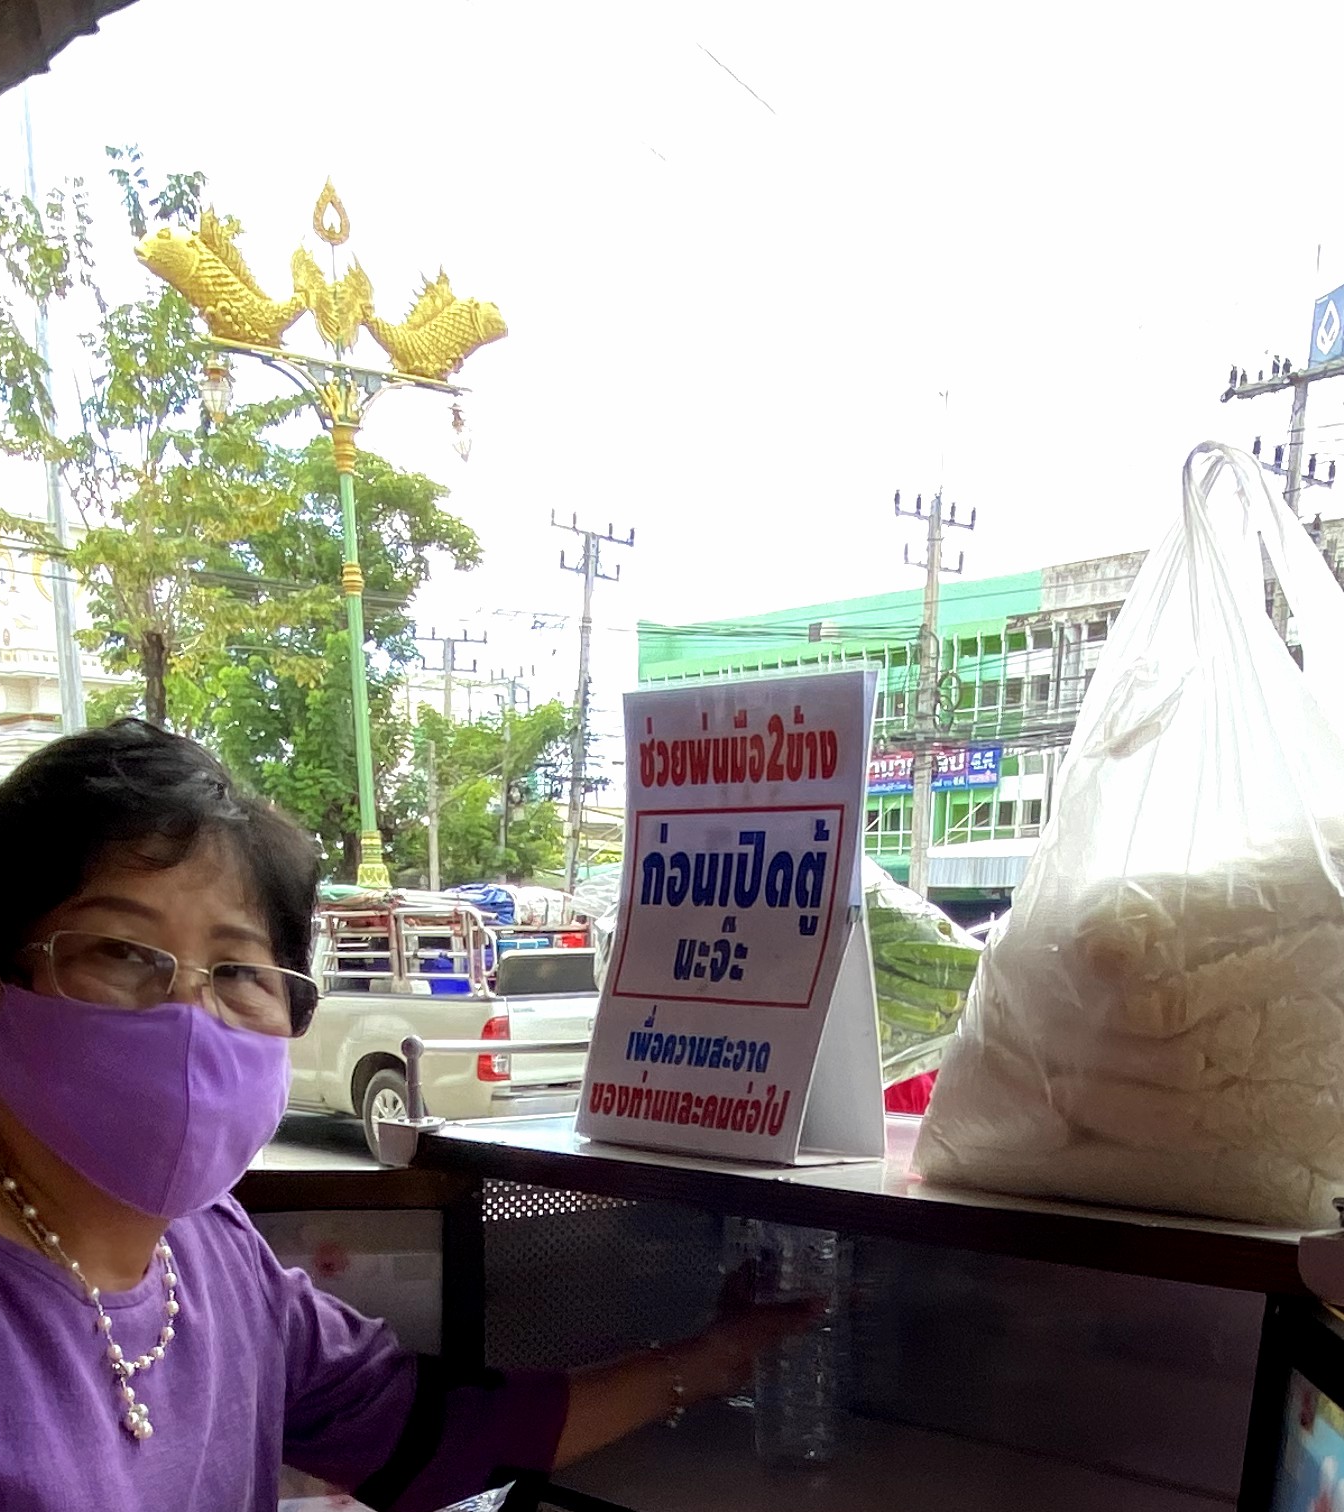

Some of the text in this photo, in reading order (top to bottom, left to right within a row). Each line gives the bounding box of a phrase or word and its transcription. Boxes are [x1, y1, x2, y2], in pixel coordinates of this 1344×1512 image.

[639, 705, 839, 788] ช่วยพ่นมือ2ข้าง
[640, 819, 830, 936] ก่อนเปิดตู้
[673, 915, 749, 982] นะจ๊ะ
[625, 1004, 772, 1074] เพื่อความสะอาด
[588, 1070, 792, 1137] ของท่านและคนต่อไป
